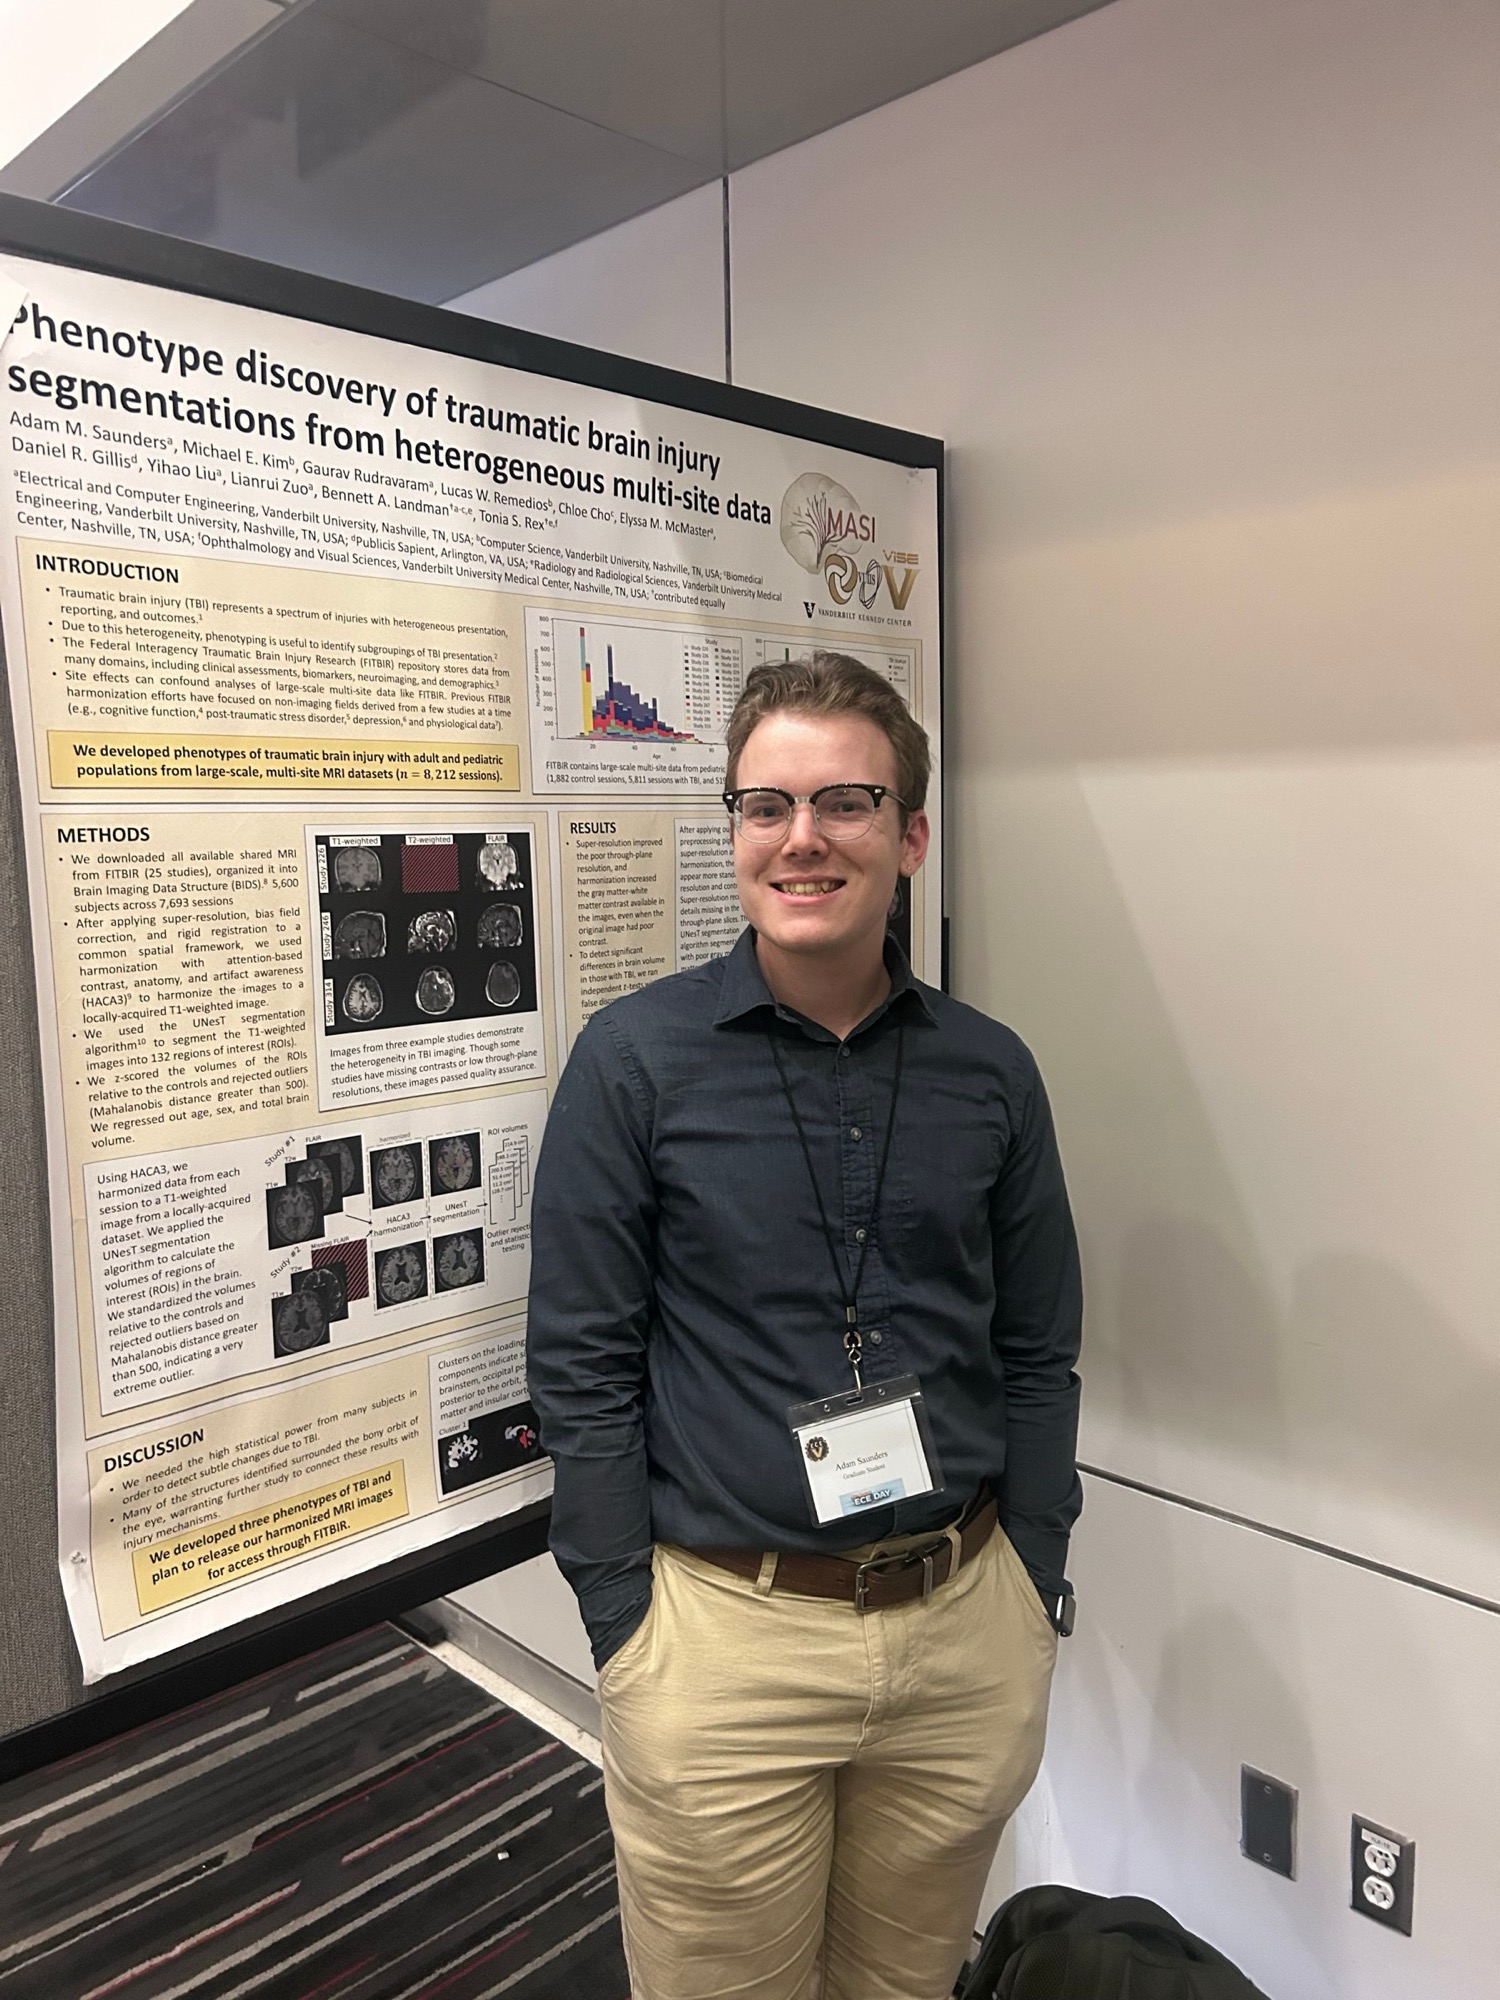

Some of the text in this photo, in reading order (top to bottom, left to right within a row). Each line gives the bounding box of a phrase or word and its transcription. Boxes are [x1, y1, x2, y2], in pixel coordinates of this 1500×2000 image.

[236, 349, 396, 416] discovery
[406, 388, 438, 418] of
[446, 395, 579, 446] traumatic
[588, 421, 649, 460] brain
[658, 437, 720, 480] injury
[8, 366, 770, 524] segmentations from heterogeneous multi-site data
[10, 411, 59, 432] Adam
[66, 420, 87, 437] M.
[183, 440, 240, 462] Michael
[246, 450, 258, 465] E.
[303, 461, 350, 479] Gaurav
[442, 483, 473, 499] Lucas
[476, 488, 490, 502] W.
[559, 502, 587, 518] Chloe
[620, 512, 647, 527] Elyssa
[650, 518, 662, 529] M.
[827, 508, 875, 543] MASI
[36, 554, 178, 583] INTRODUCTION
[59, 586, 115, 601] Traumatic
[119, 592, 146, 604] brain
[151, 595, 181, 608] injury
[185, 598, 208, 611] (TBI)
[213, 603, 264, 614] represents
[276, 609, 319, 619] spectrum
[323, 612, 332, 620] of
[336, 613, 368, 624] injuries
[371, 616, 390, 625] with
[393, 618, 454, 631] heterogeneous
[458, 626, 508, 638] presentation,
[818, 608, 912, 627] VANDERBILT KENNEDY CENTER
[73, 745, 503, 766] We developed phenotypes of traumatic brain injury with adult and pediatric
[78, 764, 157, 778] populations
[161, 764, 192, 776] from
[196, 765, 262, 779] large-scale,
[266, 766, 320, 778] multi-site
[323, 768, 344, 778] MRI
[348, 768, 393, 778] datasets
[396, 768, 408, 781] (n
[459, 770, 502, 782] sessions).
[546, 761, 568, 769] FITBIR
[600, 762, 636, 772] large-scale
[638, 764, 666, 772] multi-site
[668, 764, 681, 772] data
[683, 764, 698, 772] from
[700, 764, 725, 774] pediatric
[58, 828, 150, 843] METHODS
[571, 822, 616, 834] RESULTS
[332, 838, 378, 846] T1-weighted
[408, 836, 451, 844] T2-weighted
[576, 838, 662, 849] Super-resolution improved
[71, 850, 296, 864] We downloaded all available shared MRI
[577, 851, 652, 861] the poor through-plane
[75, 897, 233, 914] subjects across 7,693 sessions
[330, 1026, 524, 1057] Images from three example studies demonstrate
[265, 1136, 296, 1167] Study #1
[98, 1164, 188, 1184] Using HACA3, we
[98, 1168, 240, 1200] harmonized data from each
[433, 1209, 480, 1222] segmentation
[445, 1201, 467, 1211] UNesT
[387, 1213, 410, 1224] HACA3
[374, 1222, 423, 1237] harmonization
[311, 1236, 349, 1250] Missing FLAIR
[270, 1246, 301, 1279] Study #2
[104, 1429, 203, 1472] DISCUSSION
[835, 1451, 889, 1471] Adam Saunders
[843, 1464, 886, 1480] Graduate Student
[854, 1495, 872, 1506] ECE
[873, 1489, 891, 1500] DAY
[150, 1471, 391, 1564] We developed three phenotypes of TBI and
[152, 1489, 393, 1585] plan to release our harmonized MRI images
[208, 1521, 350, 1580] for access through FITBIR.
